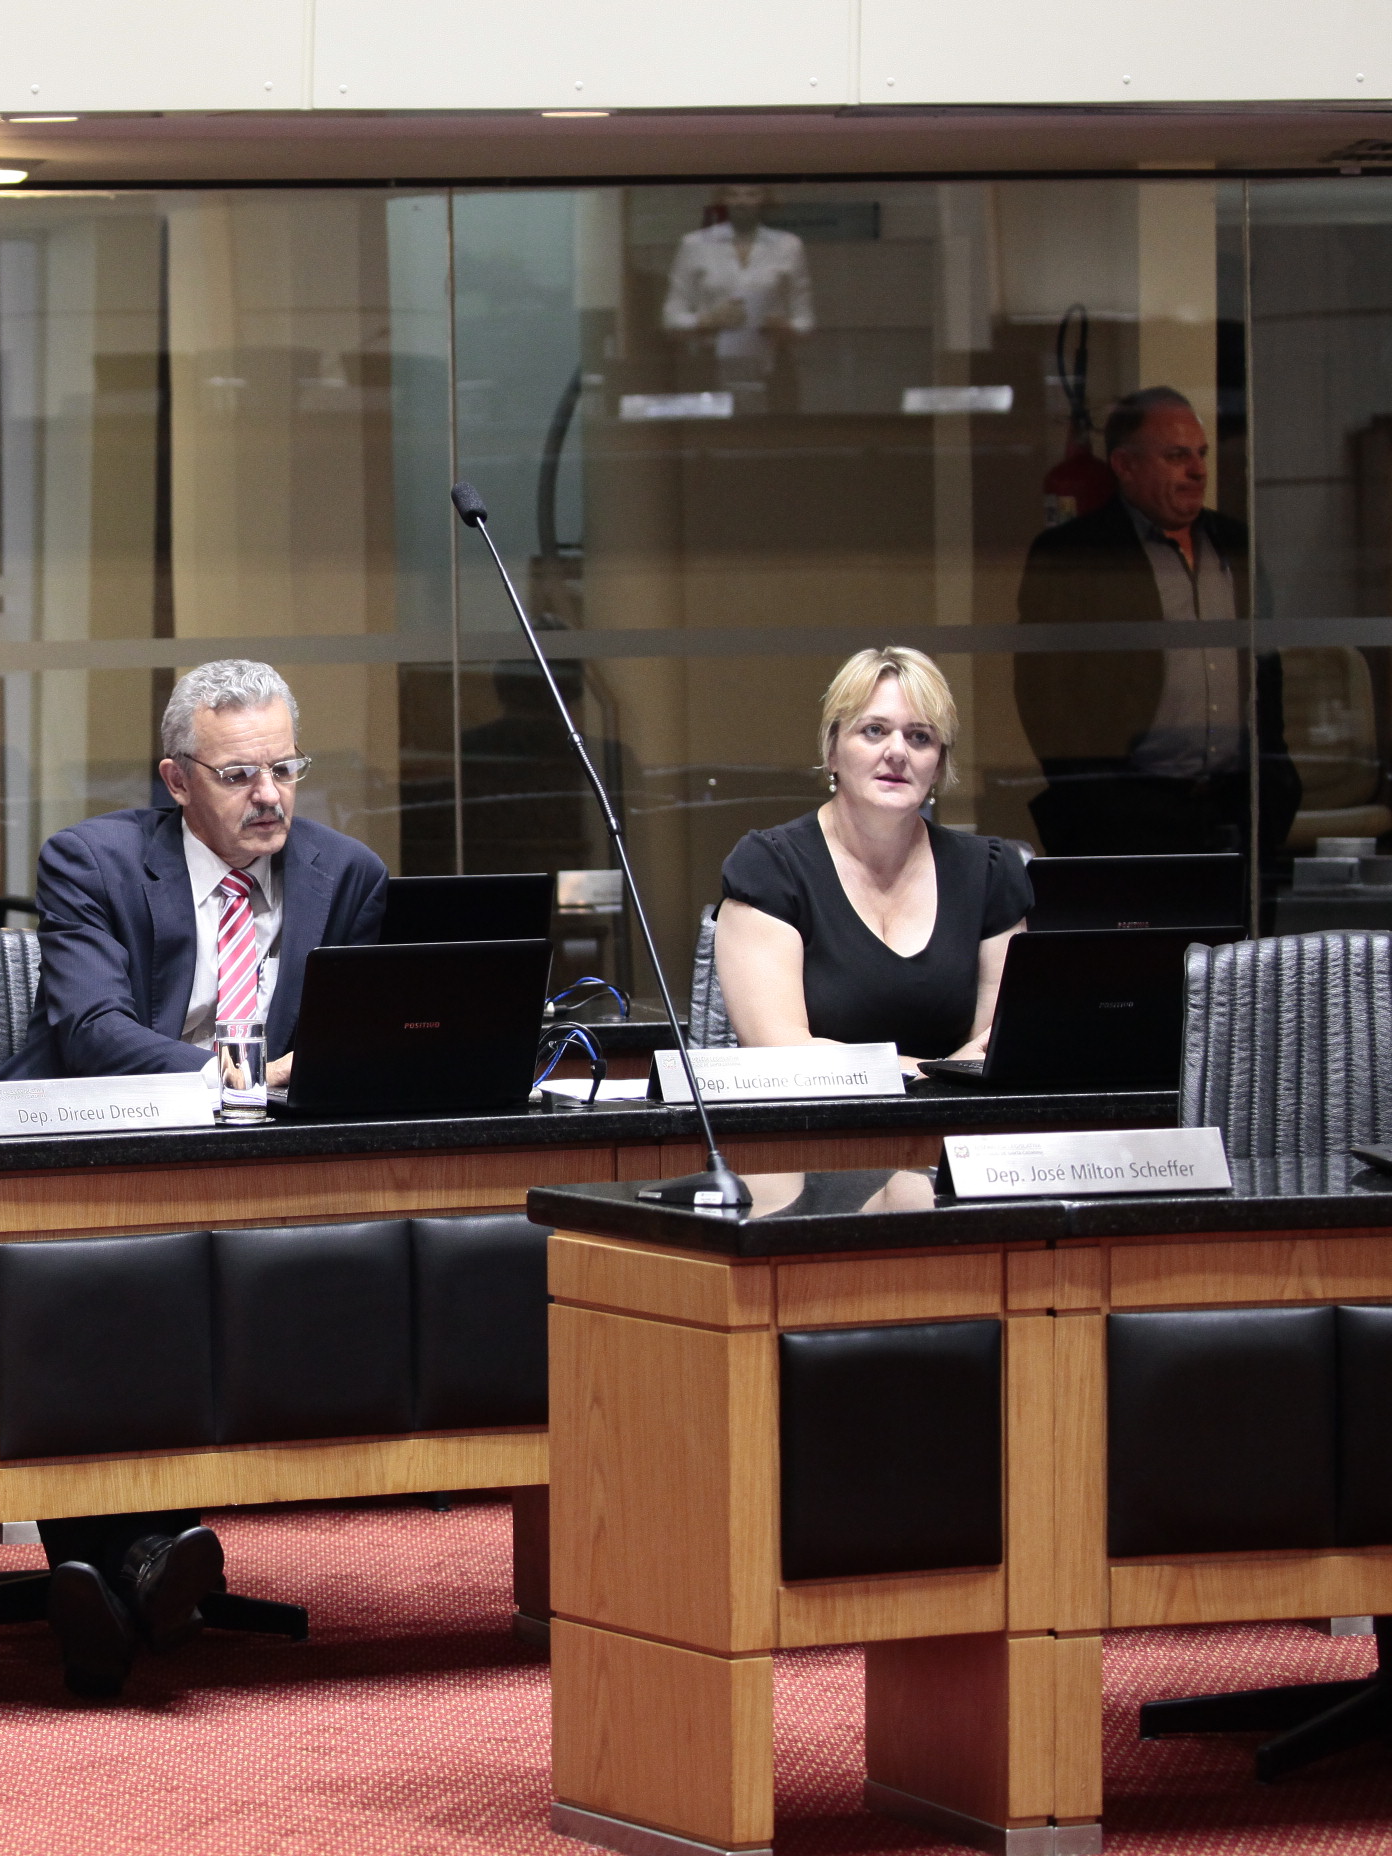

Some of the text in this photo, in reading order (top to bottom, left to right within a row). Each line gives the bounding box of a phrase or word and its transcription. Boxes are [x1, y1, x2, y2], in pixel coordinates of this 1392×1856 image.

[696, 1070, 869, 1094] Dep. Luciane Carminatti
[17, 1102, 160, 1127] Dep. Dirceu Dresch
[986, 1159, 1196, 1186] Dep. José Milton Scheffer
